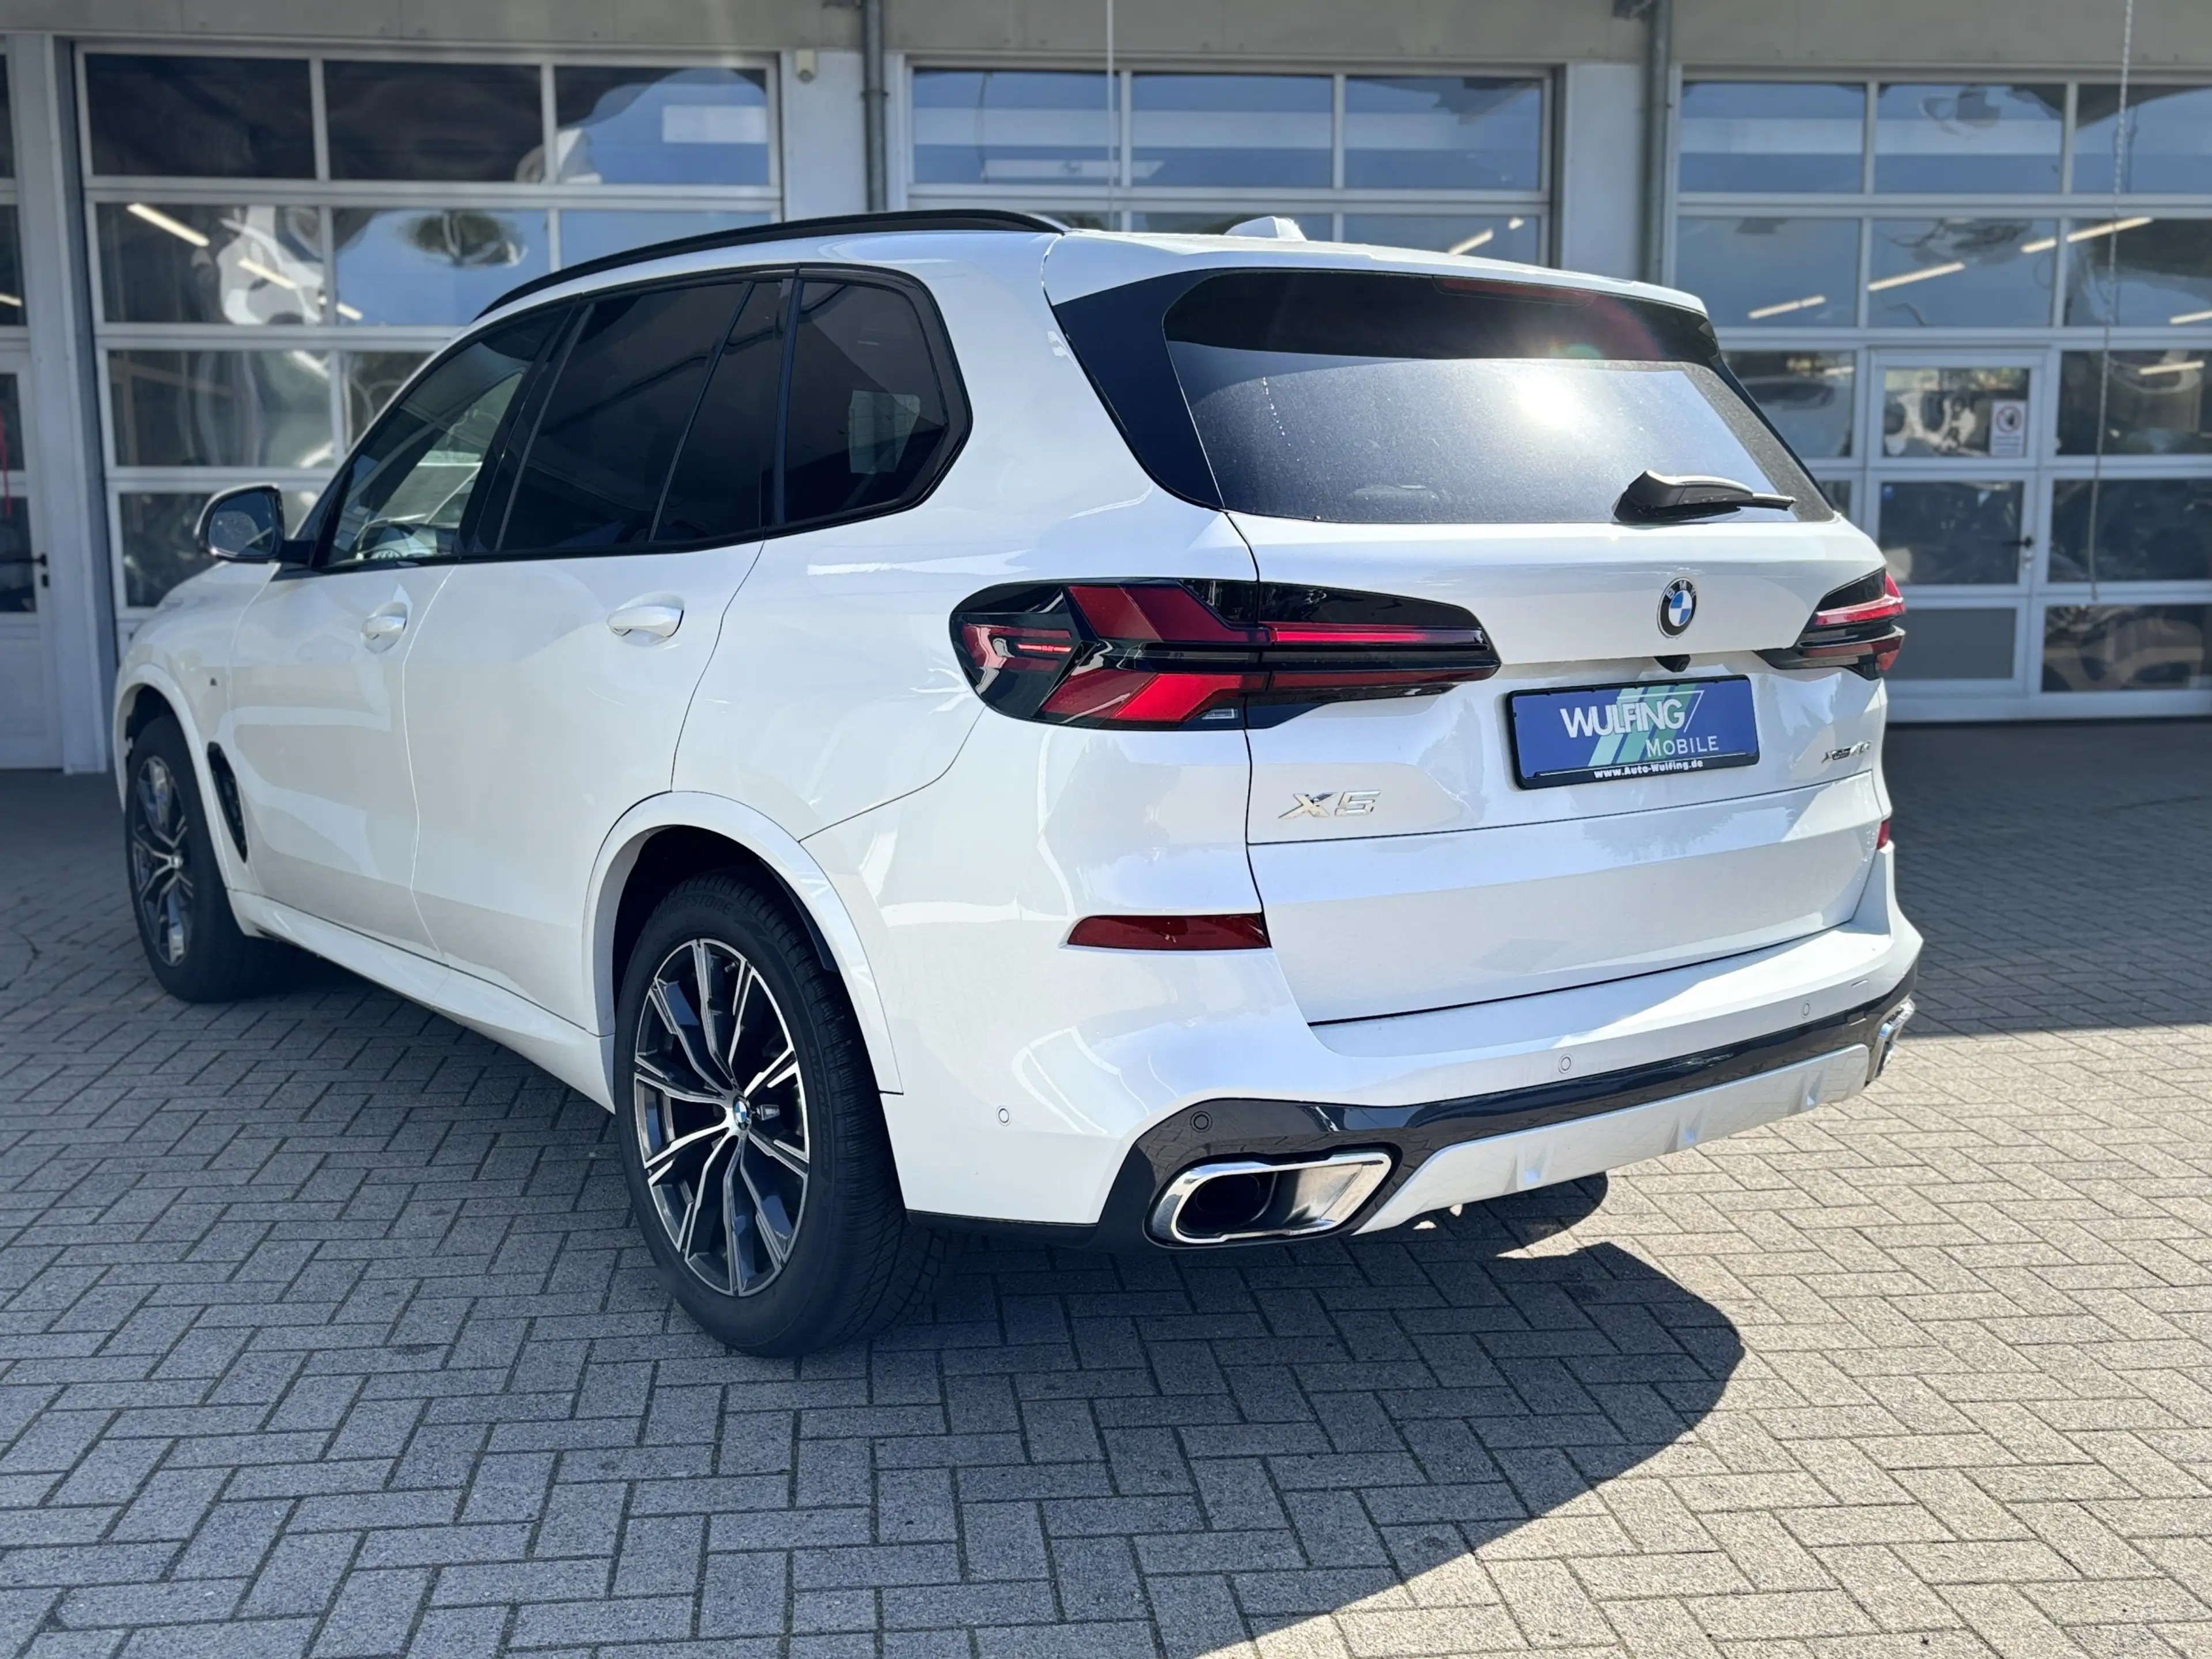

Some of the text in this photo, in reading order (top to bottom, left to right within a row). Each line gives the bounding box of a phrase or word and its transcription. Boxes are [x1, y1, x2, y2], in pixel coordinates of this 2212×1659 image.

[1665, 580, 1696, 599] BMW
[1560, 699, 1685, 738] WULFING
[1645, 736, 1719, 757] MOBILE
[1594, 760, 1703, 778] www.Auto-Wulfing.de
[1278, 790, 1381, 819] X5
